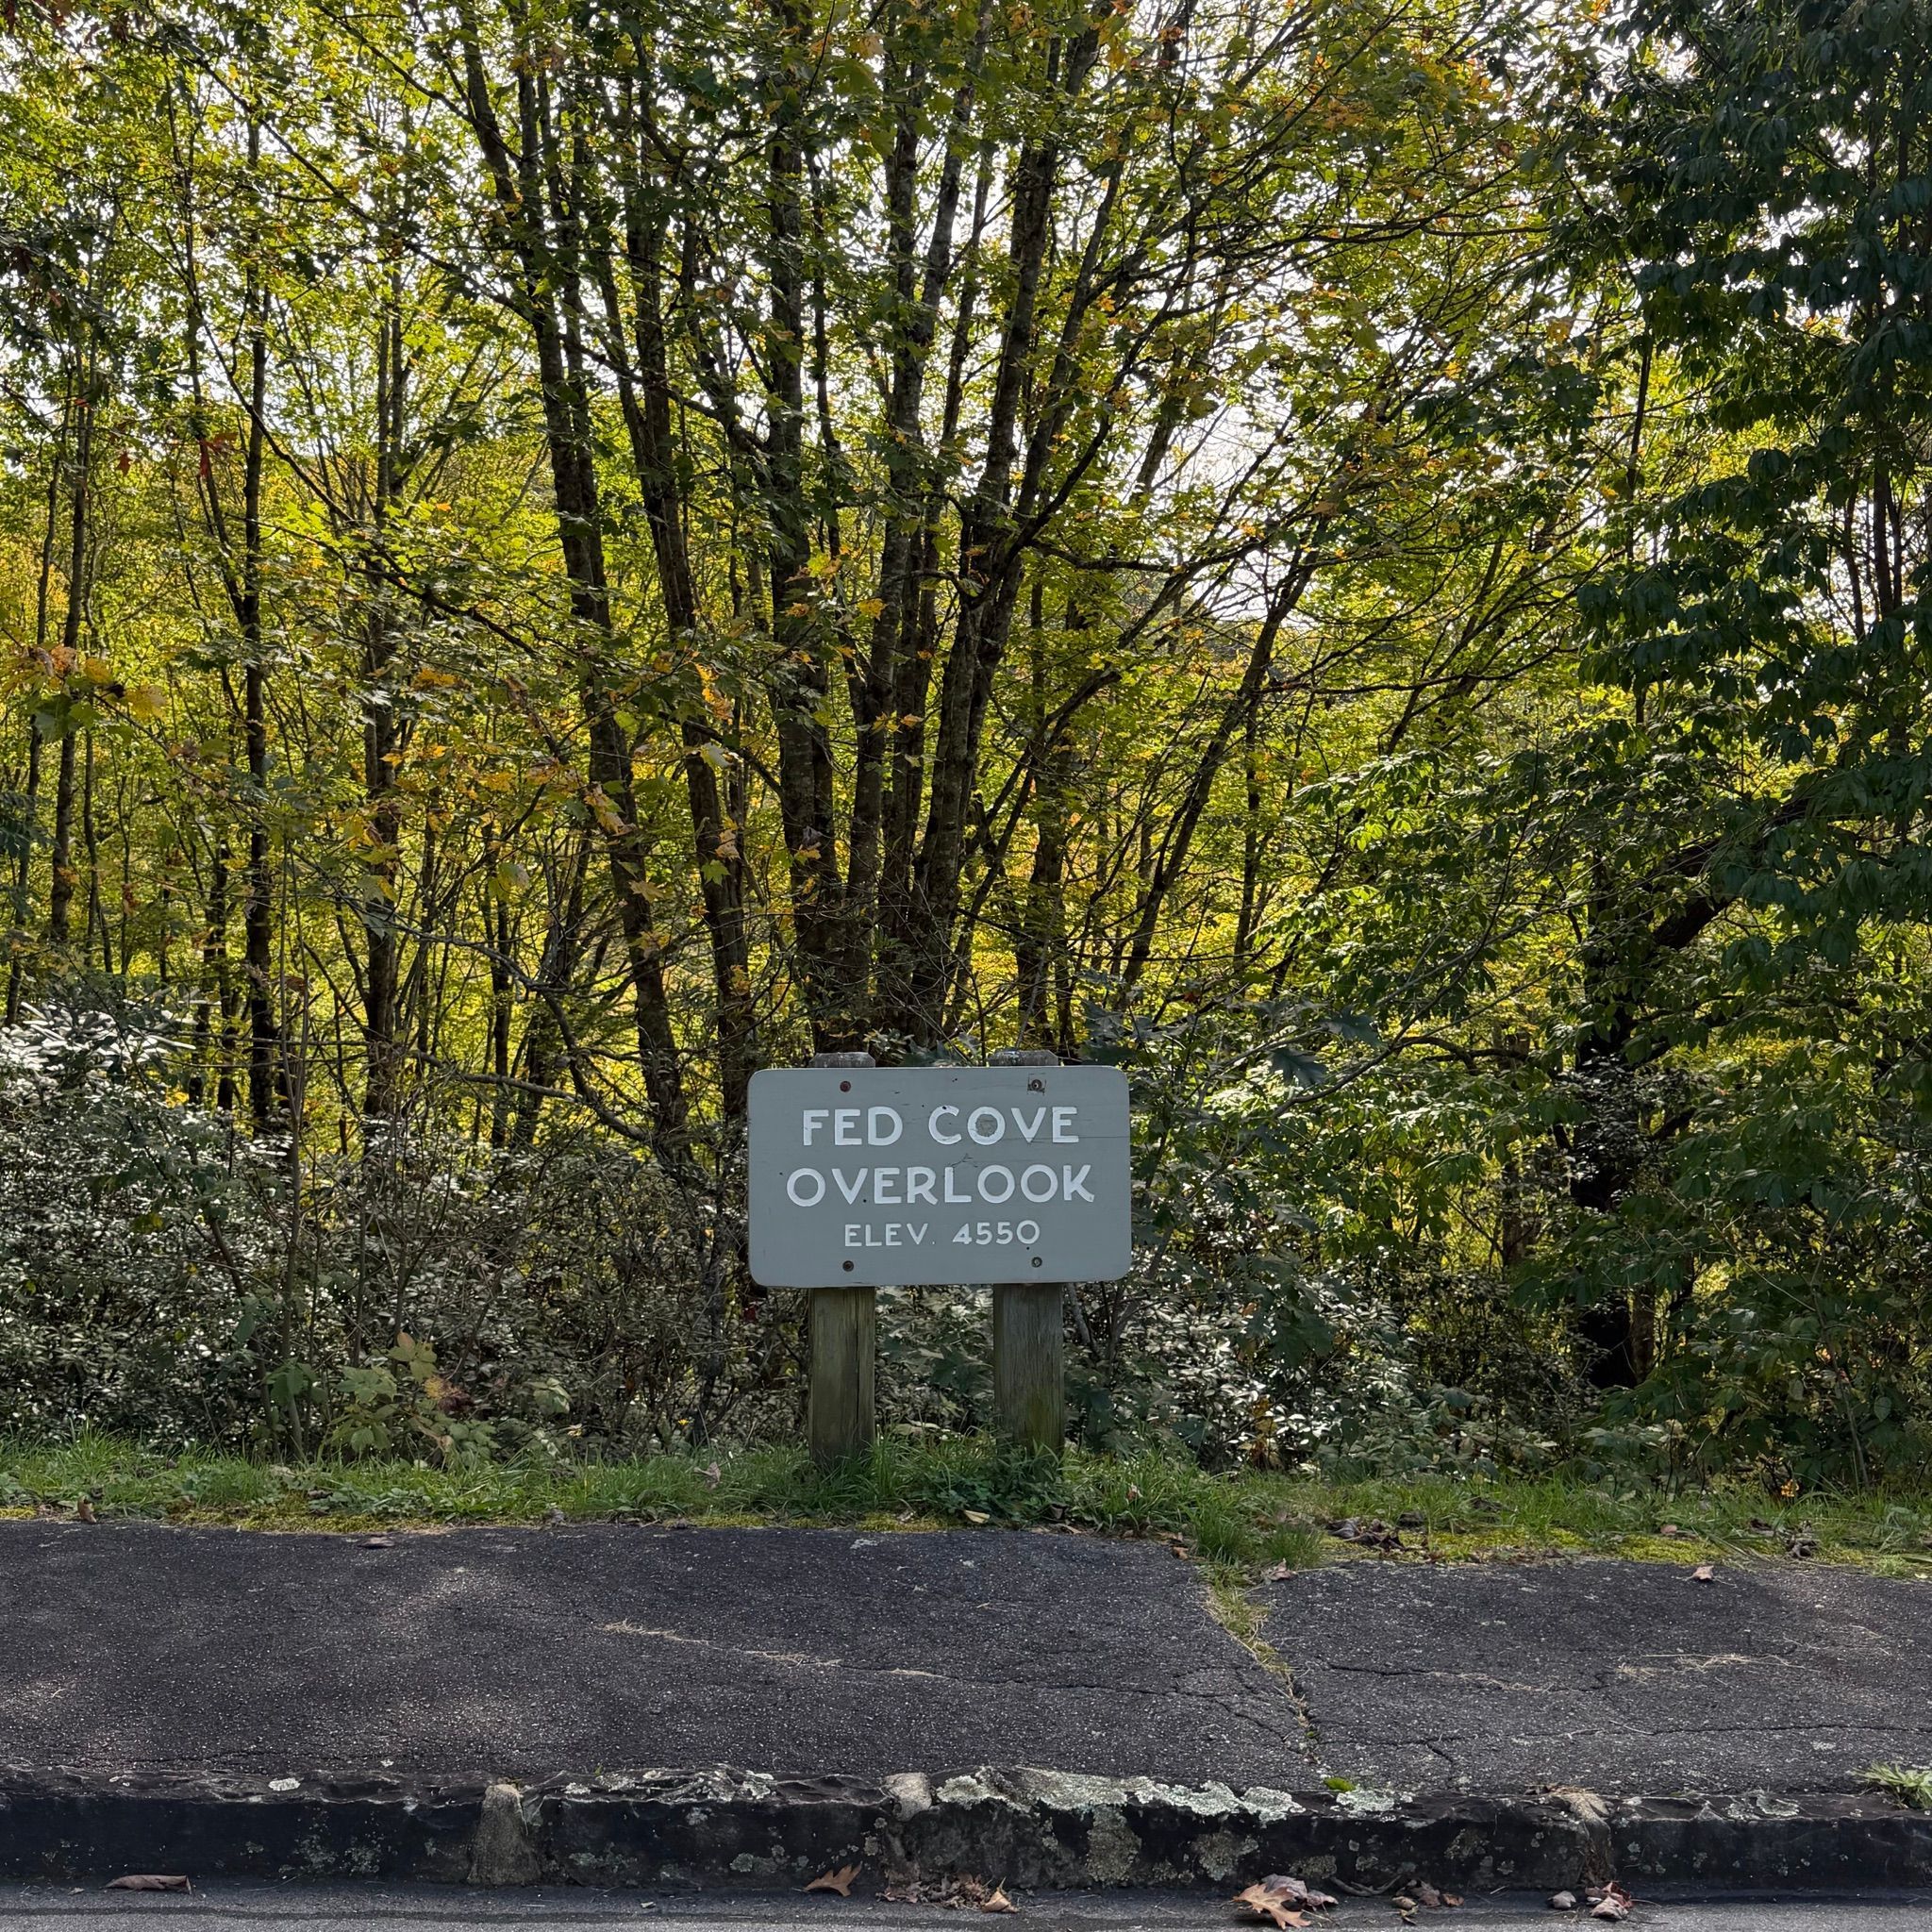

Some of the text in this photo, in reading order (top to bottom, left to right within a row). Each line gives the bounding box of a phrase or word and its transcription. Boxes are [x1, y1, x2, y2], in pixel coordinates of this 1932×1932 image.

[802, 1105, 1080, 1146] FED COVE
[786, 1164, 1095, 1208] OVERLOOK
[951, 1219, 1041, 1245] 4550
